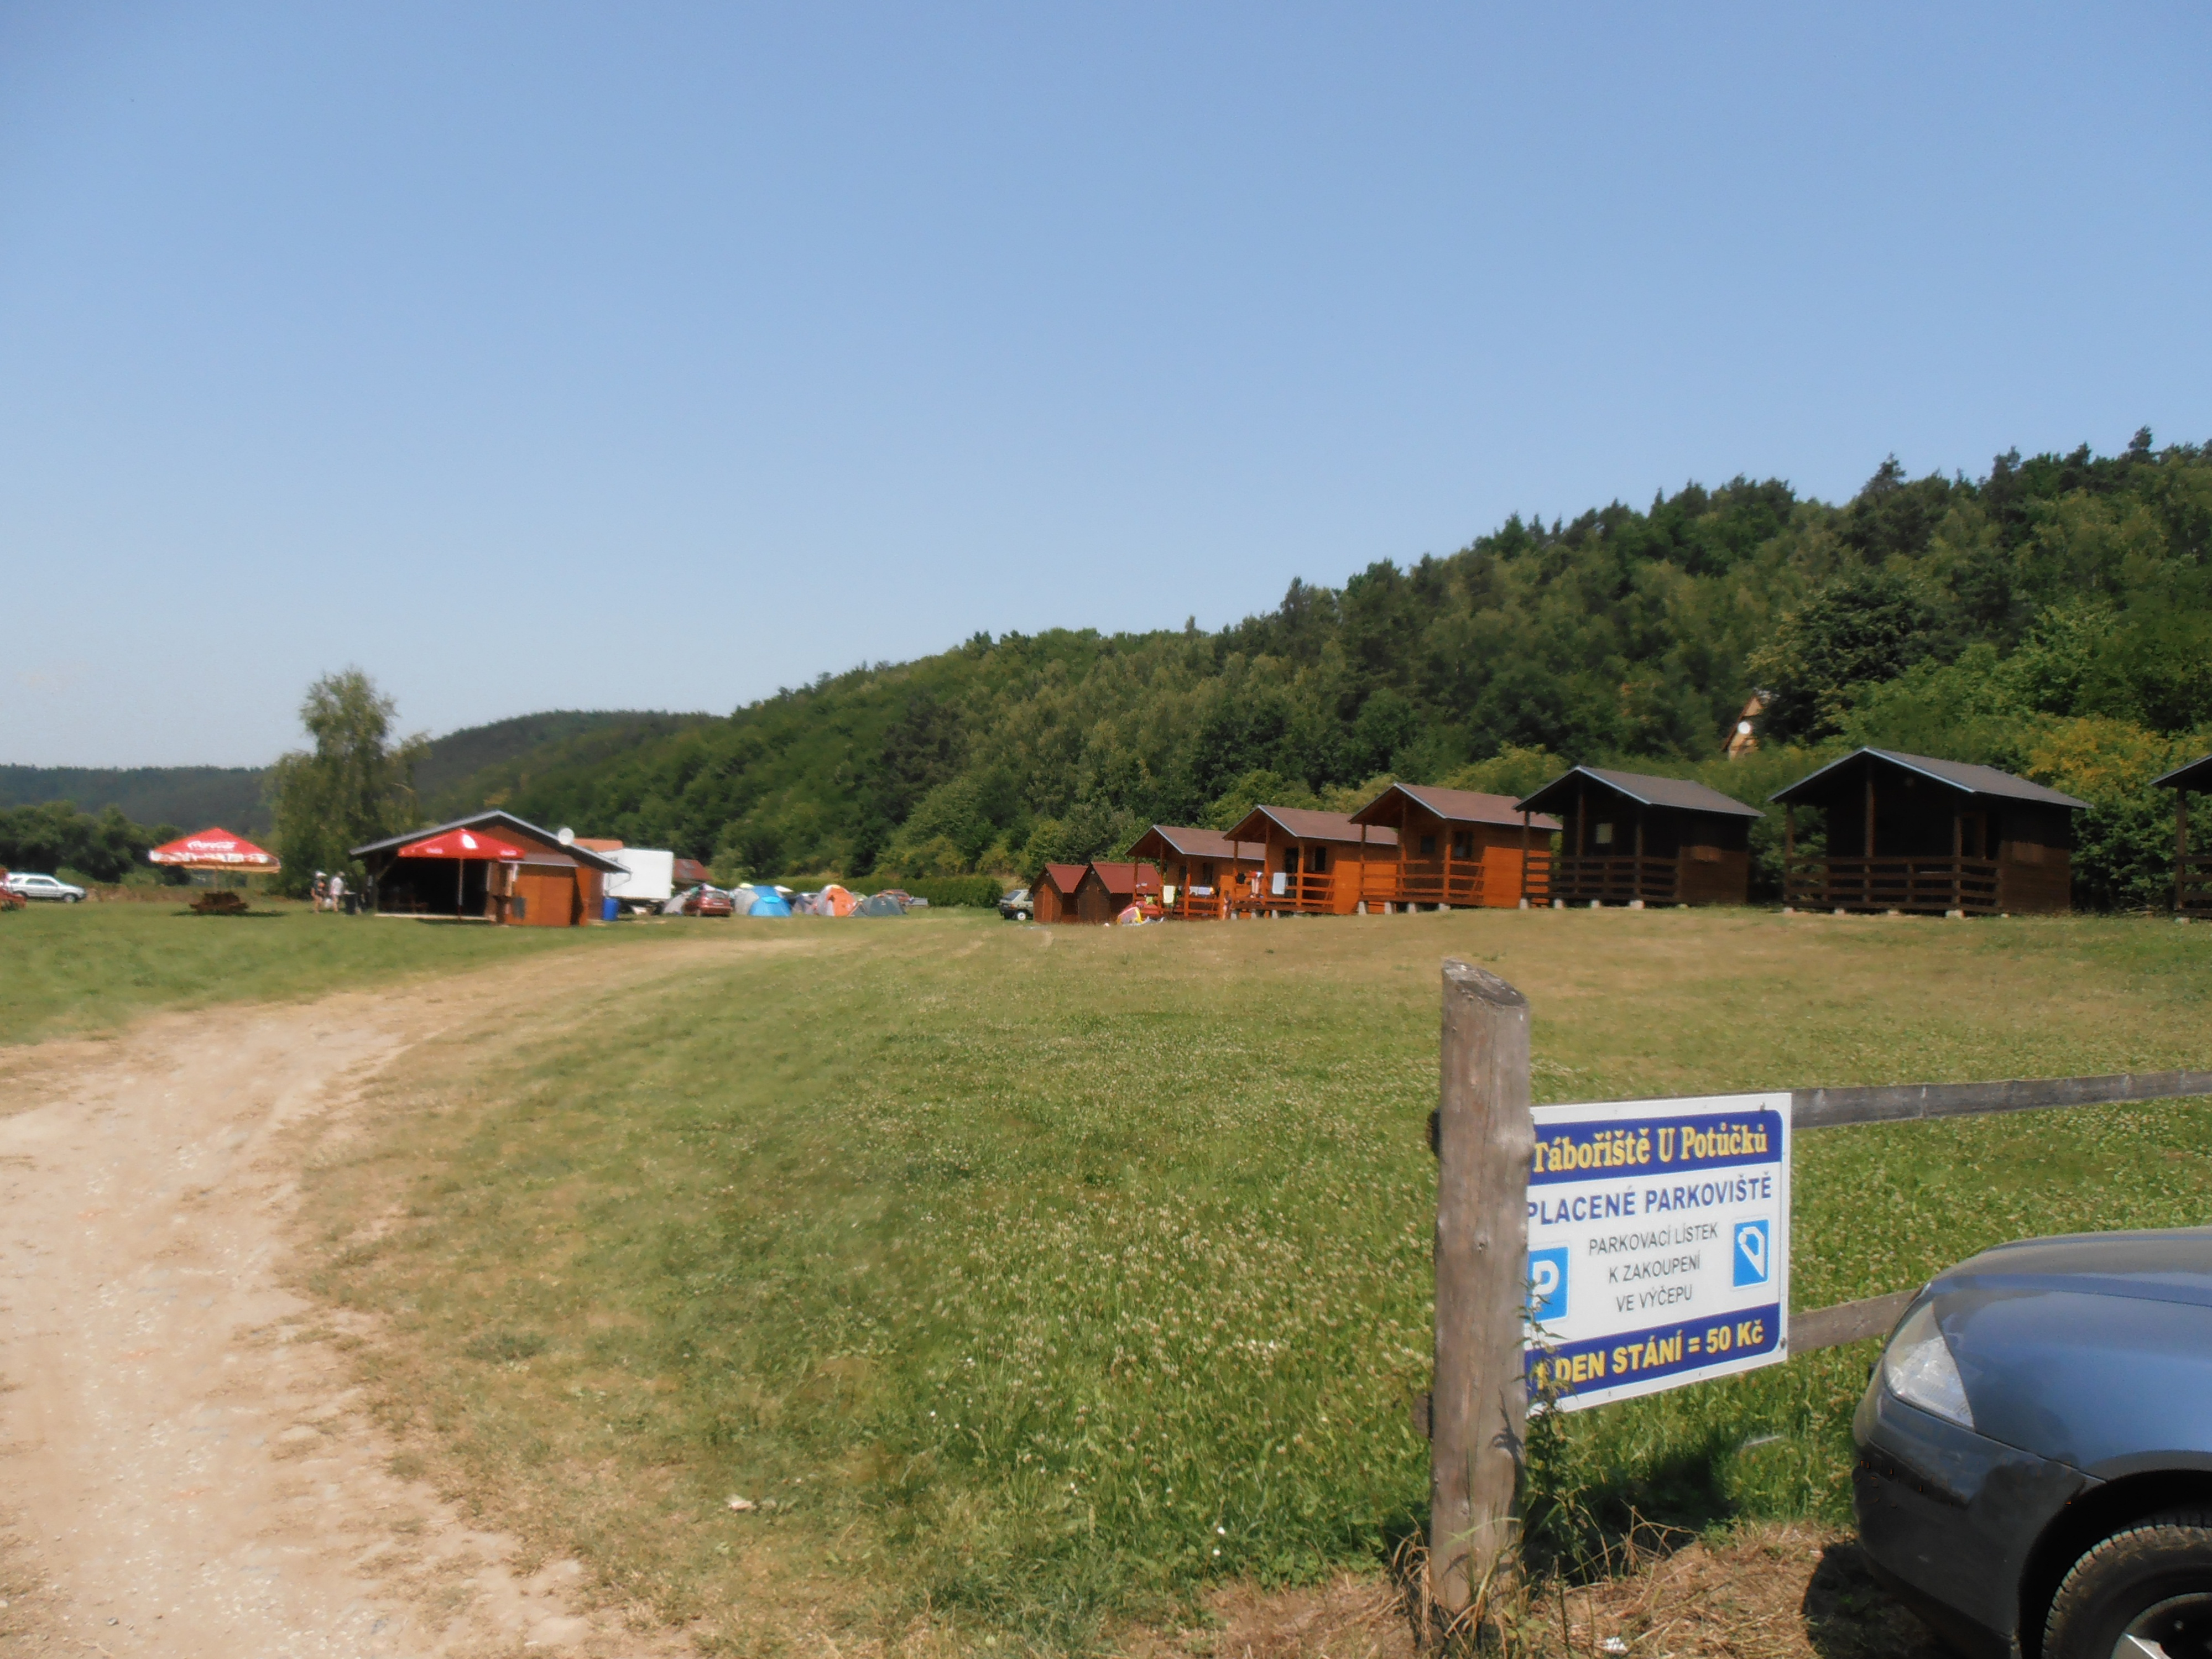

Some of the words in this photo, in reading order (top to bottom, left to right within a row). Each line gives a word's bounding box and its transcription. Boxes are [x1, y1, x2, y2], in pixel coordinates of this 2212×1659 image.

[1533, 1127, 1651, 1173] Tábořiště
[1658, 1127, 1676, 1162] U
[1680, 1121, 1768, 1160] Potůčků
[1528, 1185, 1636, 1225] PLACENÉ
[1645, 1170, 1772, 1213] PARKOVIŠTĚ
[1589, 1224, 1671, 1256] PARKOVACÍ
[1674, 1222, 1718, 1245] LÍSTEK
[1609, 1266, 1619, 1284] K
[1623, 1249, 1700, 1282] ZAKOUPENÍ
[1616, 1294, 1635, 1312] VE
[1639, 1284, 1693, 1309] VÝČEPU
[1555, 1350, 1606, 1384] DEN
[1612, 1329, 1683, 1374] STÁNÍ
[1688, 1337, 1701, 1353] =
[1706, 1326, 1731, 1354] 50
[1737, 1319, 1765, 1348] Kč
